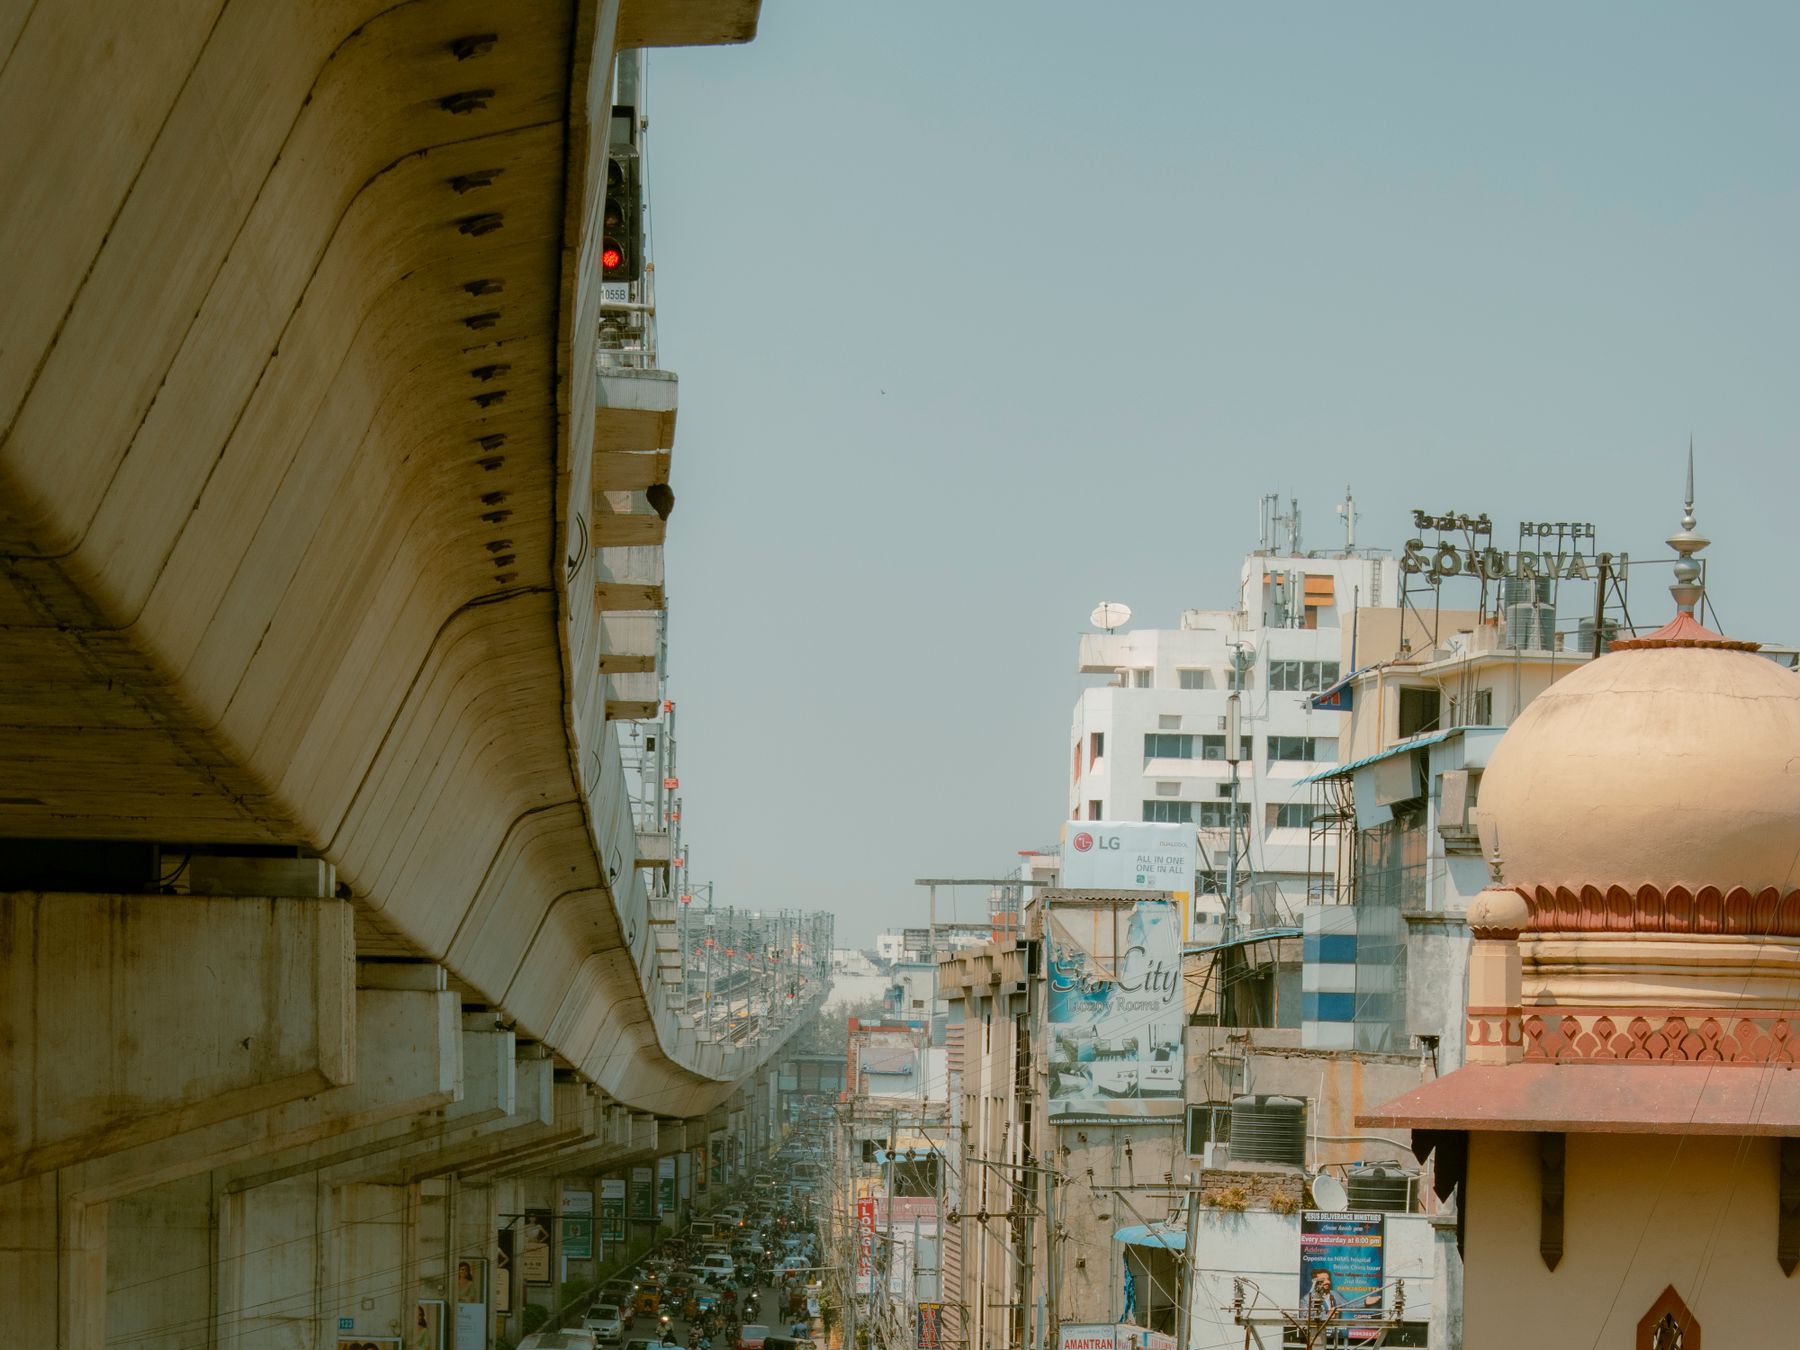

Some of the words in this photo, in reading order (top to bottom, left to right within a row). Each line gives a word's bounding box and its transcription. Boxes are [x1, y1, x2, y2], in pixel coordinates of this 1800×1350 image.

[1519, 521, 1595, 538] HOTEL
[1098, 836, 1121, 850] LG
[1136, 855, 1152, 863] ALL
[1154, 855, 1164, 863] IN
[1165, 856, 1185, 865] ONE
[1135, 864, 1154, 873] ONE
[1156, 865, 1167, 873] IN
[1168, 865, 1184, 874] ALL
[1119, 945, 1179, 1003] City
[1304, 1212, 1320, 1220] JESUS
[1320, 1213, 1353, 1221] DELIVERANCE
[1301, 1236, 1318, 1244] Every
[1319, 1236, 1346, 1245] saturday
[1064, 1338, 1113, 1350] AMANTRAN
